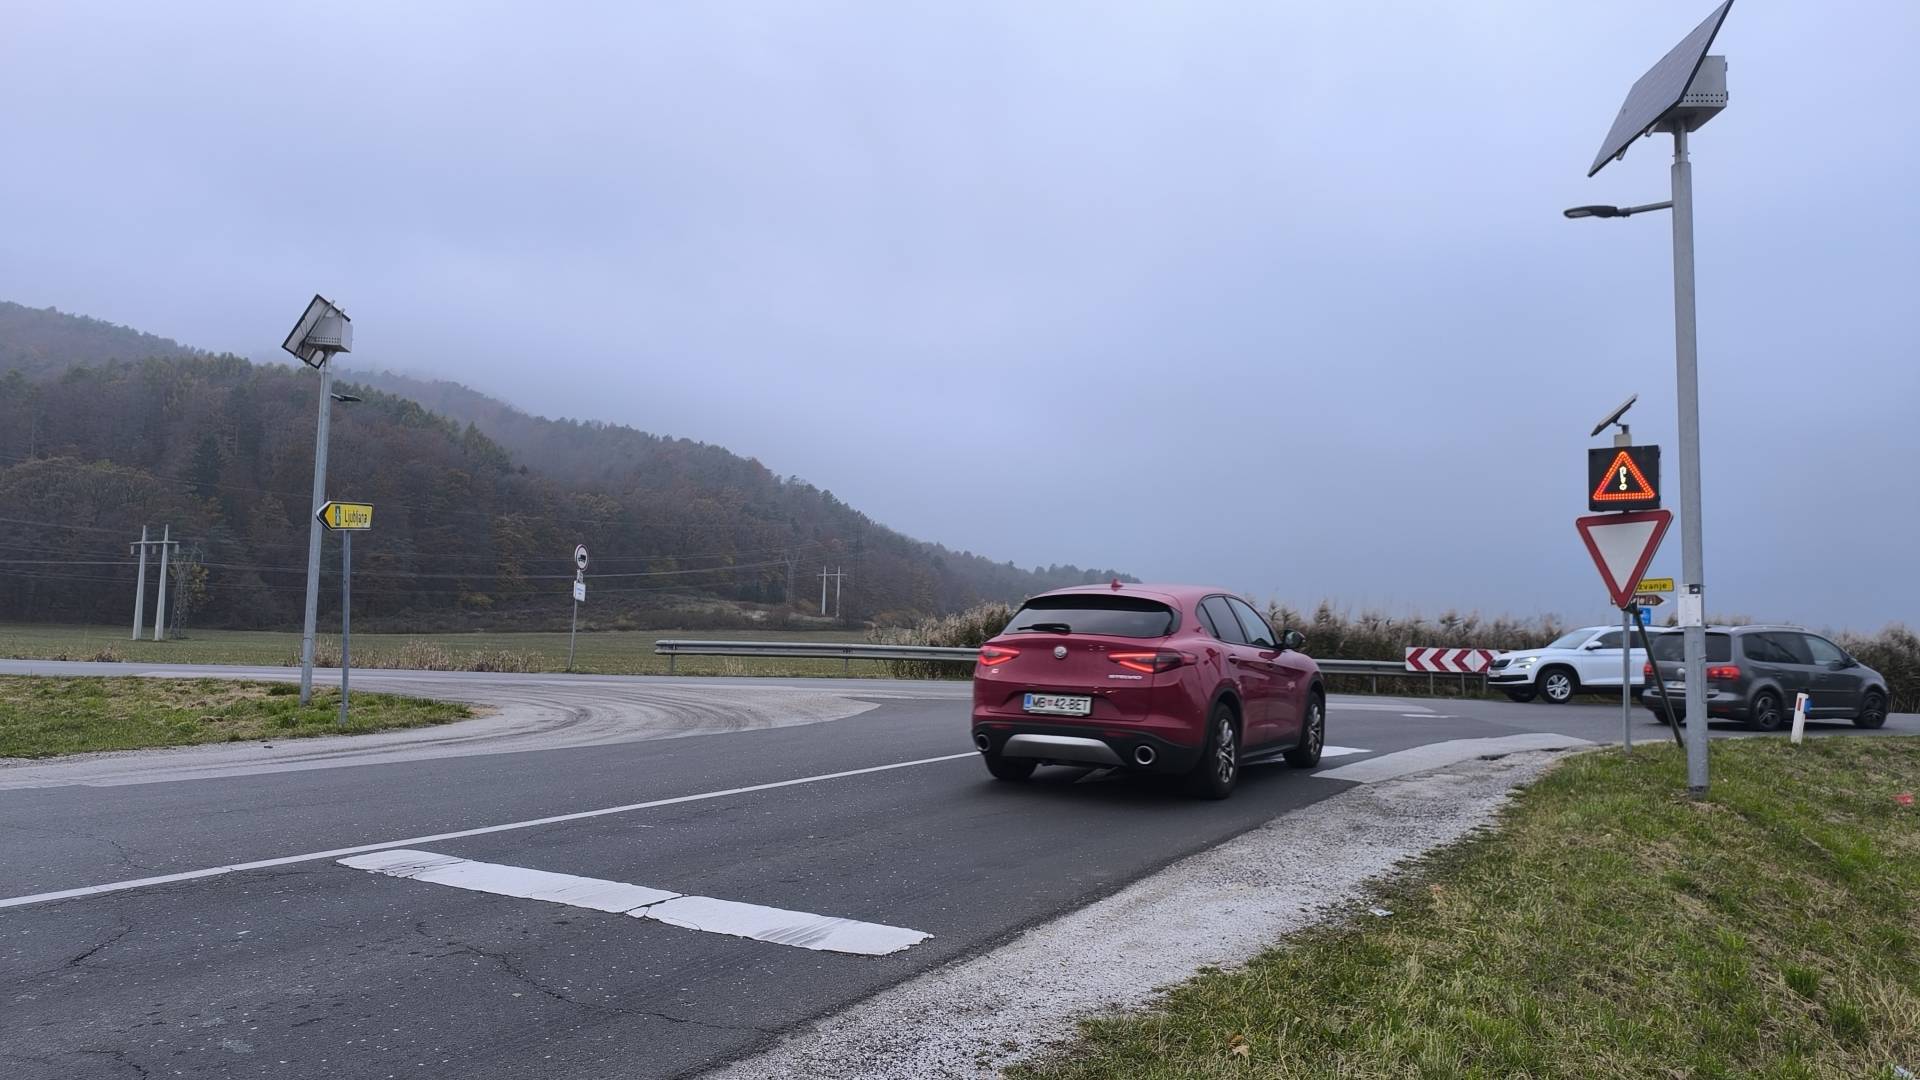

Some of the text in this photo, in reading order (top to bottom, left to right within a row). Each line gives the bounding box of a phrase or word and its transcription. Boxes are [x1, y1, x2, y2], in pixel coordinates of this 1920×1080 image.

[1638, 583, 1668, 591] zvanje
[1032, 696, 1089, 711] MB 42-BET
